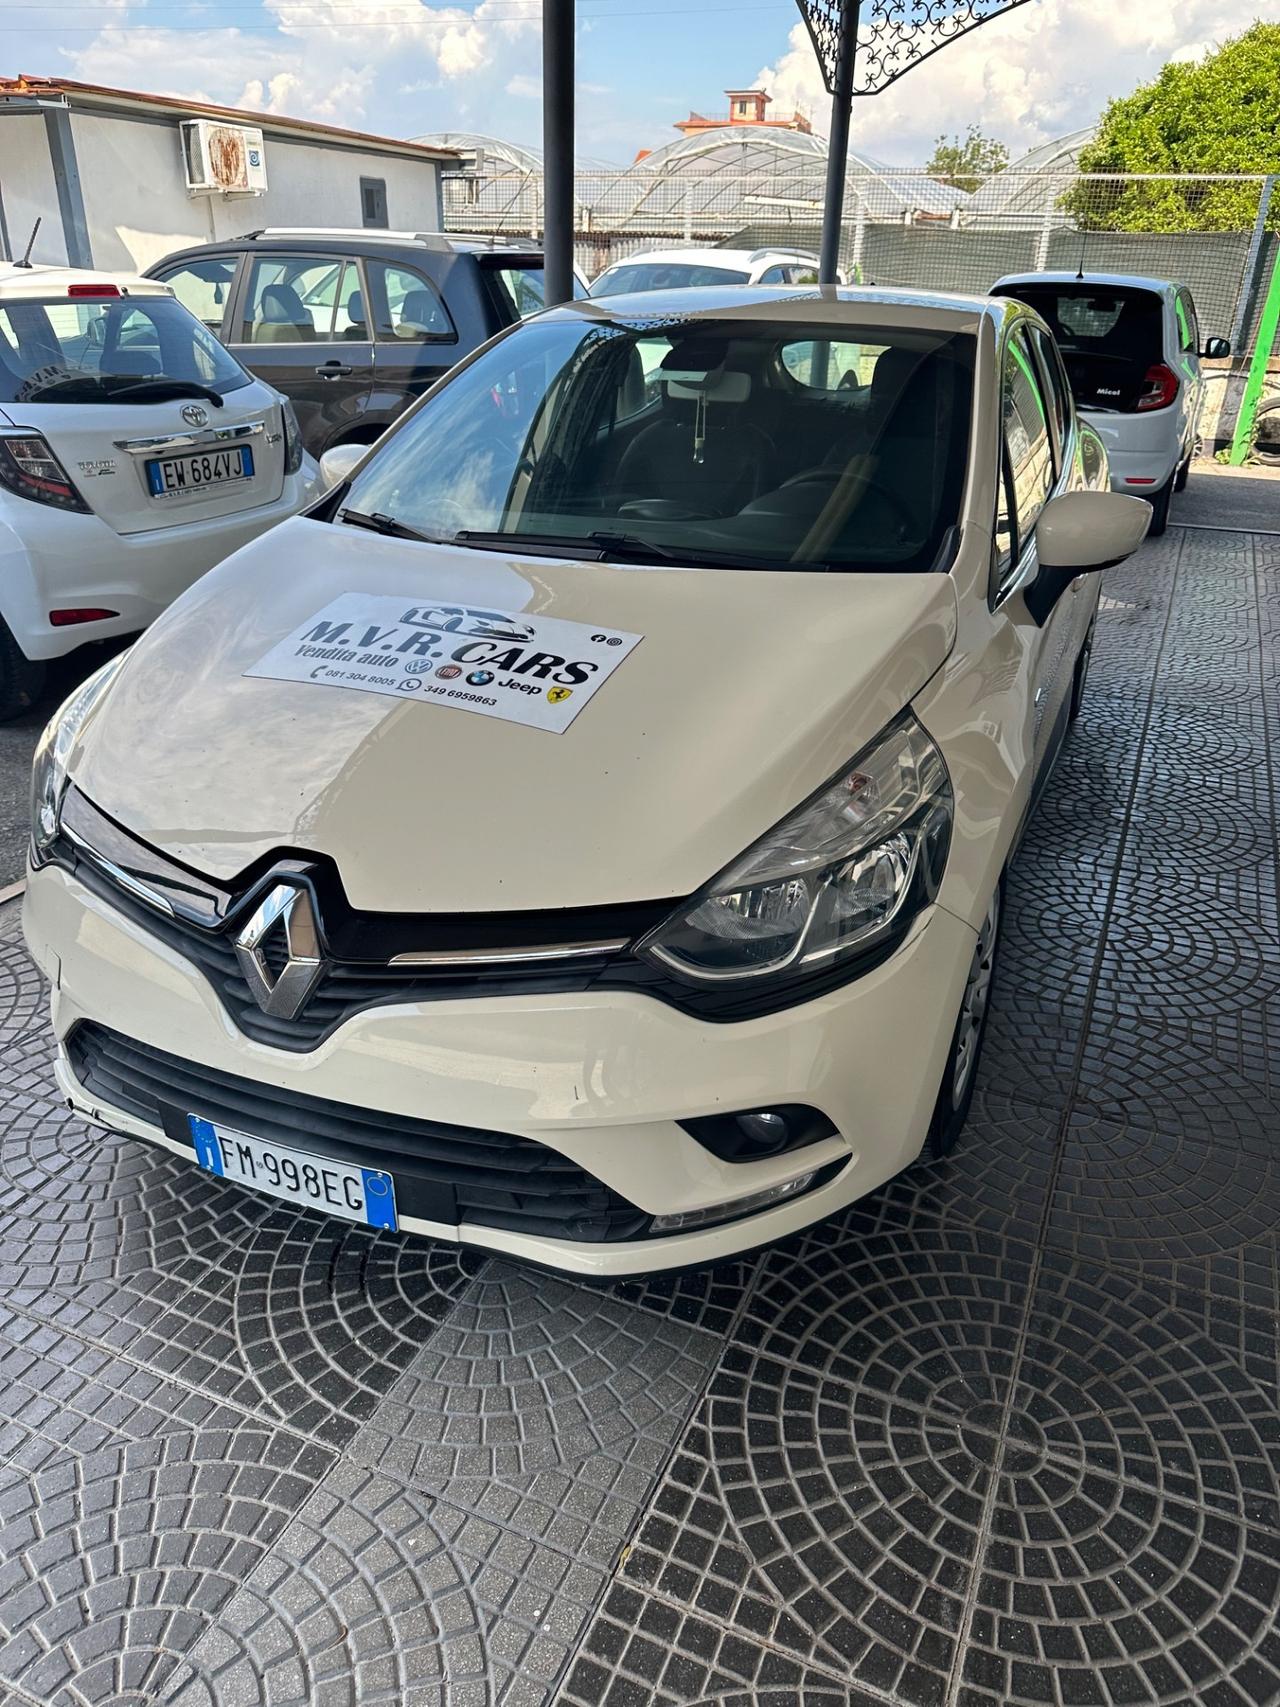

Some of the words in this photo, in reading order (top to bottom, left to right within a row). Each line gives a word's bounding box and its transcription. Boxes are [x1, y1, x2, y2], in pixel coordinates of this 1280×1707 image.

[163, 461, 186, 488] EW
[191, 451, 242, 483] 684VJ
[295, 645, 357, 662] Vendita
[357, 653, 399, 667] auto
[300, 620, 443, 658] M.V.R.
[450, 641, 599, 685] CARS
[346, 672, 367, 681] 304
[367, 676, 396, 685] 8005
[424, 685, 446, 695] 349
[447, 690, 497, 706] 6959863
[498, 678, 542, 696] Jeep
[218, 1136, 257, 1179] FM
[262, 1152, 363, 1210] 998EG
